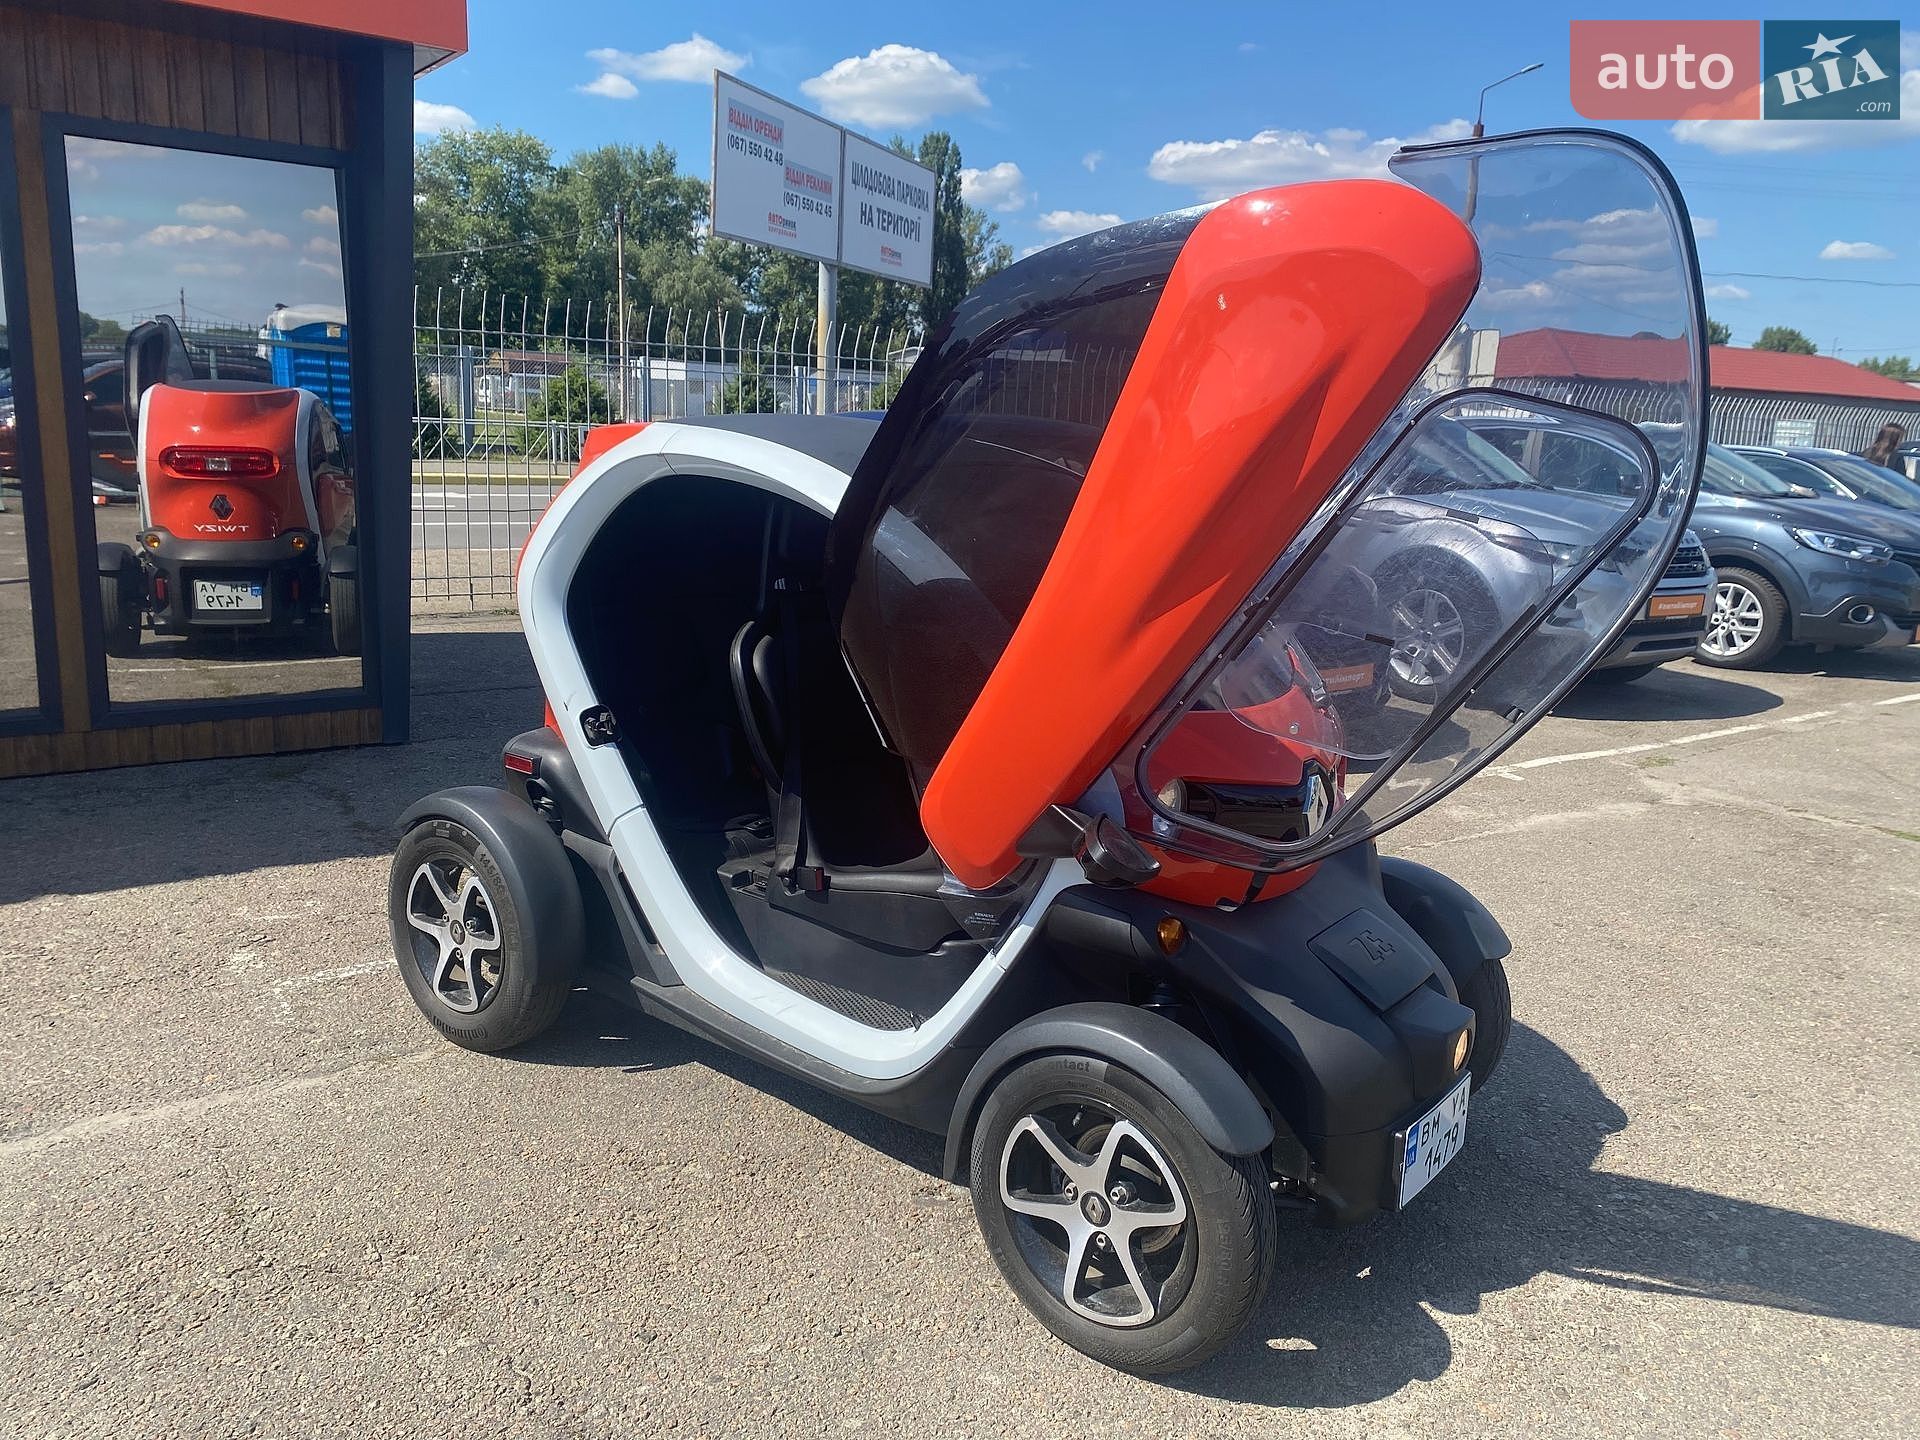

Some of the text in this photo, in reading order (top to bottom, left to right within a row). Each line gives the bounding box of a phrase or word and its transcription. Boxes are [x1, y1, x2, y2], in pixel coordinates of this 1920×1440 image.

[728, 106, 783, 144] ВІДДІЛ ОРЕНДИ
[727, 132, 784, 166] (067) 550 42 48
[783, 191, 833, 218] (067) 550 42 45
[851, 161, 929, 213] ЦІЛОДОБОВА ПАРКОВКА
[860, 201, 921, 243] НА ТЕРИТОРІЇ
[1421, 1086, 1466, 1148] BM YA
[1424, 1122, 1459, 1179] 1479
